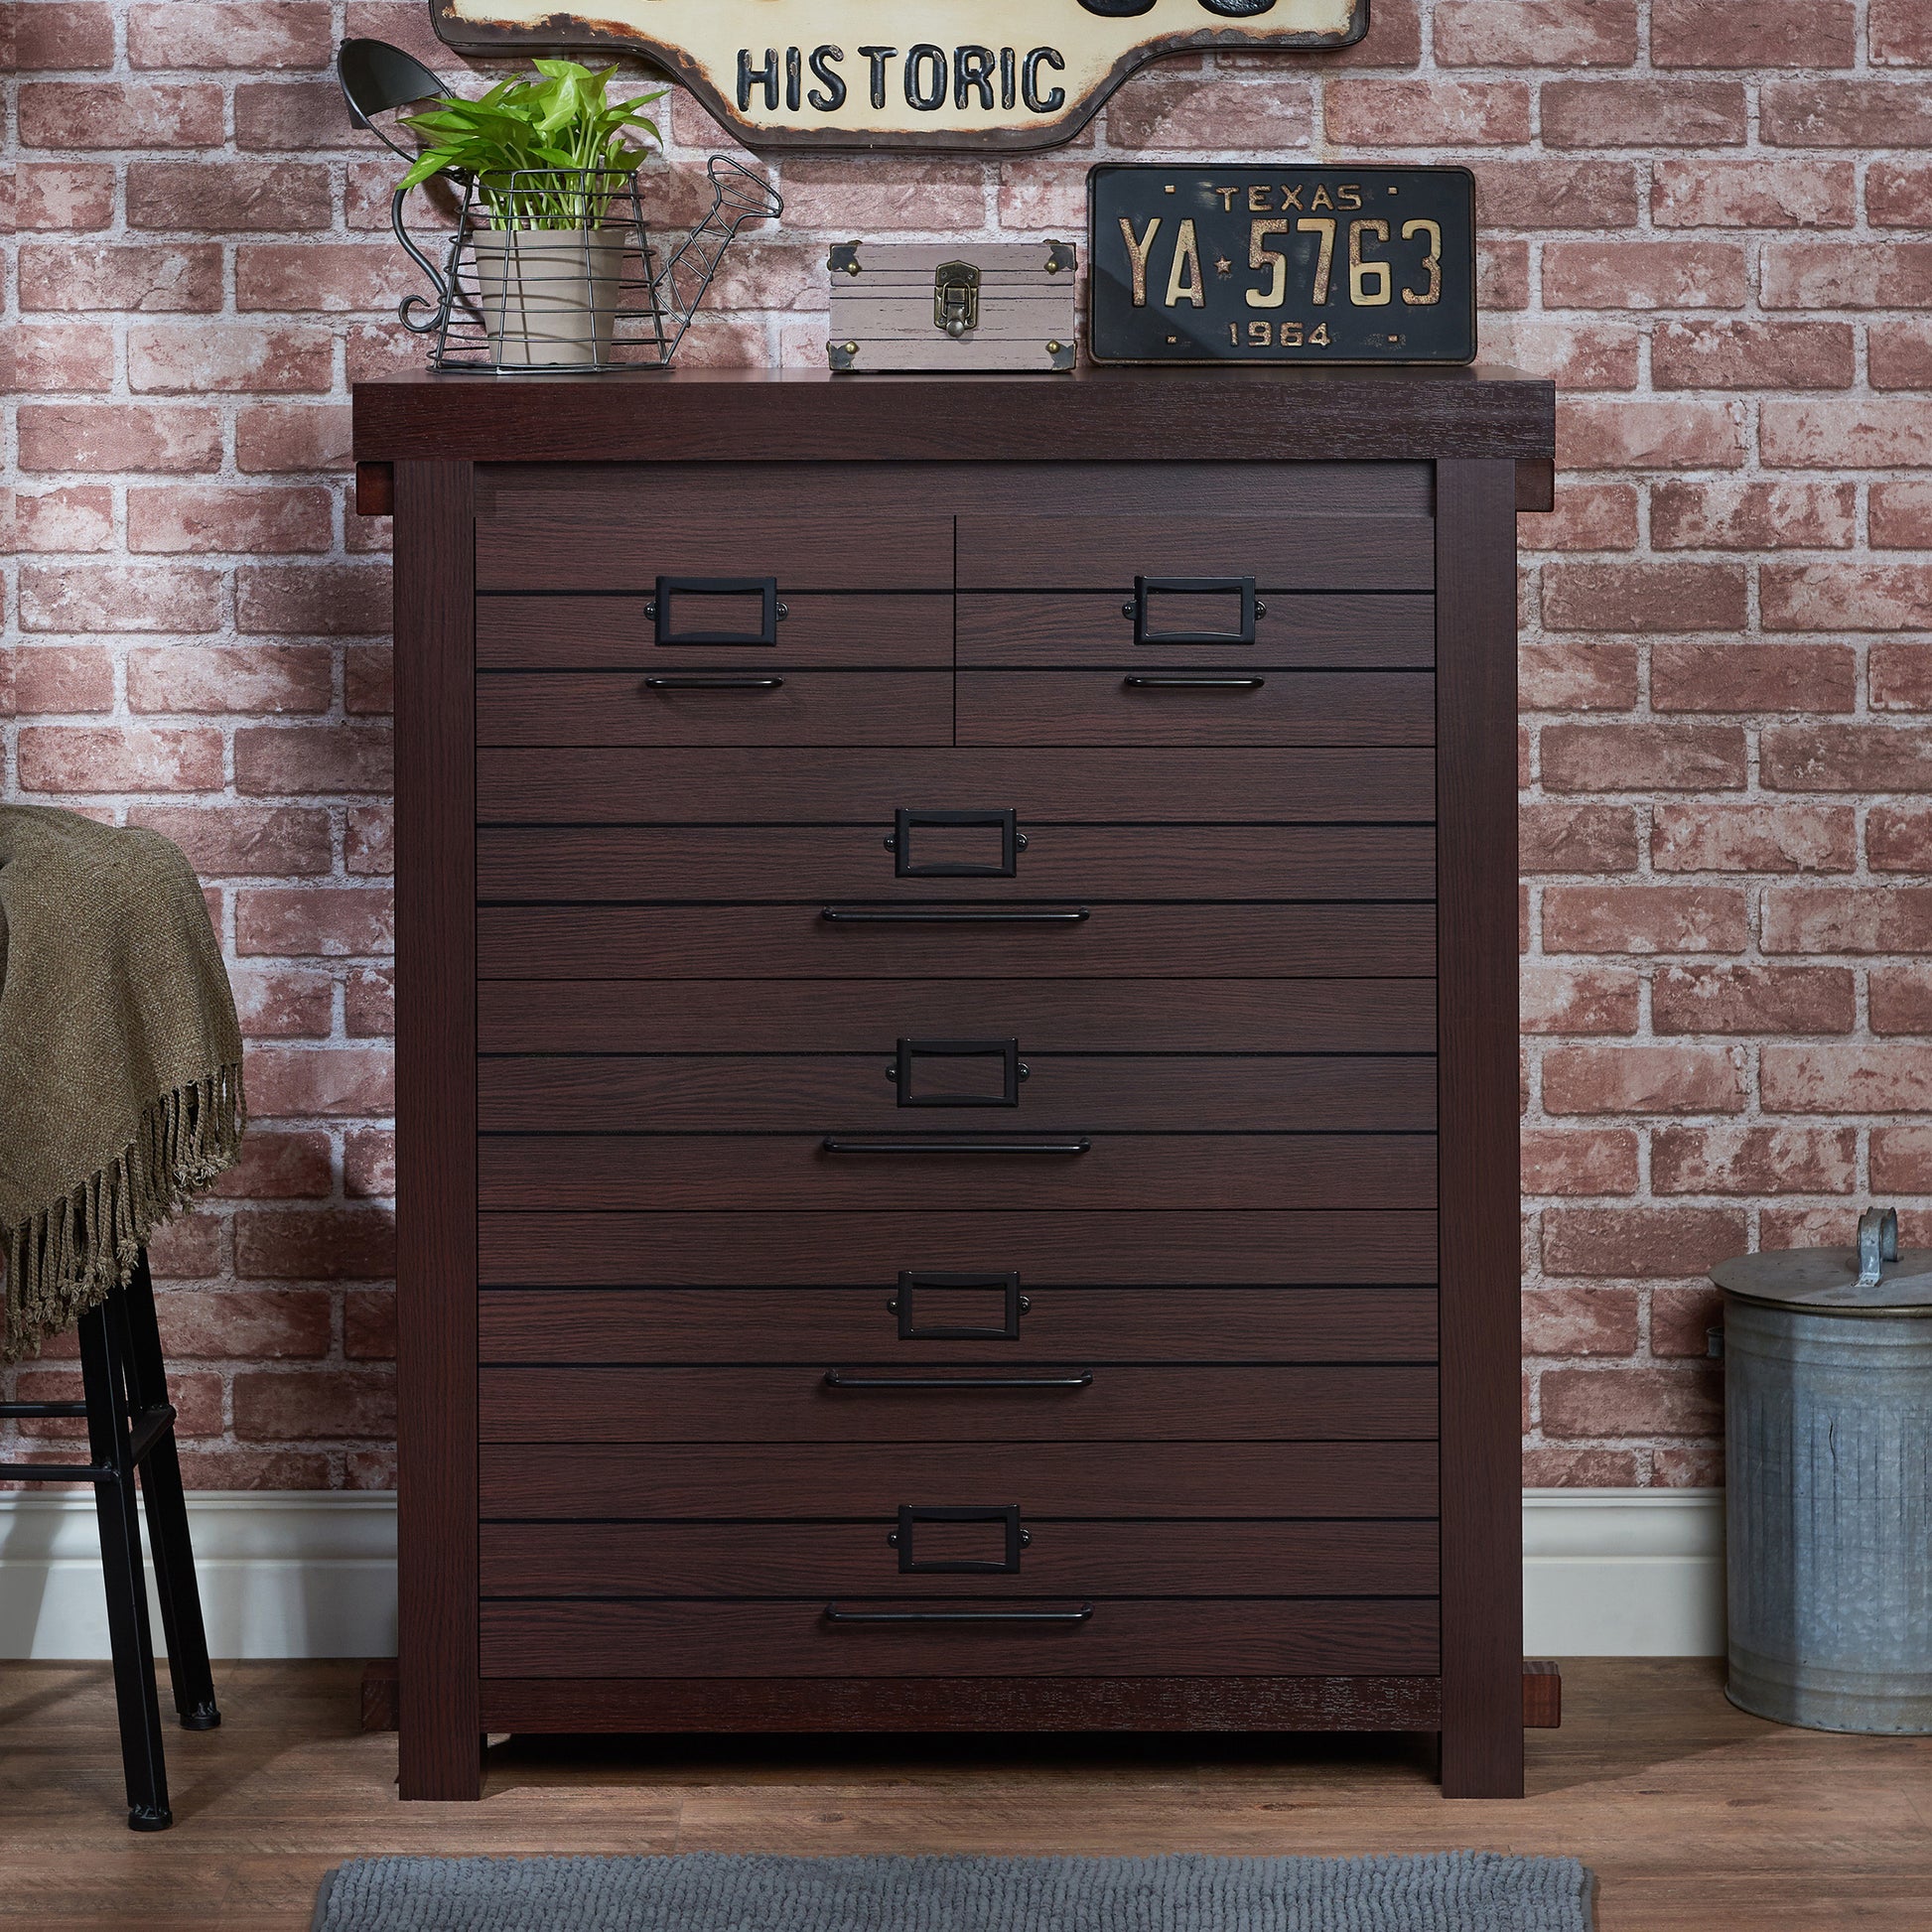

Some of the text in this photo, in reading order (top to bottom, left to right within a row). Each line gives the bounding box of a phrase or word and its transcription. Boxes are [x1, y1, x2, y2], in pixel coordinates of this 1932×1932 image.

[736, 44, 1066, 113] HISTORIC
[1215, 184, 1363, 212] TEXAS
[1118, 216, 1444, 309] YA 5763
[1228, 321, 1332, 347] 1964
